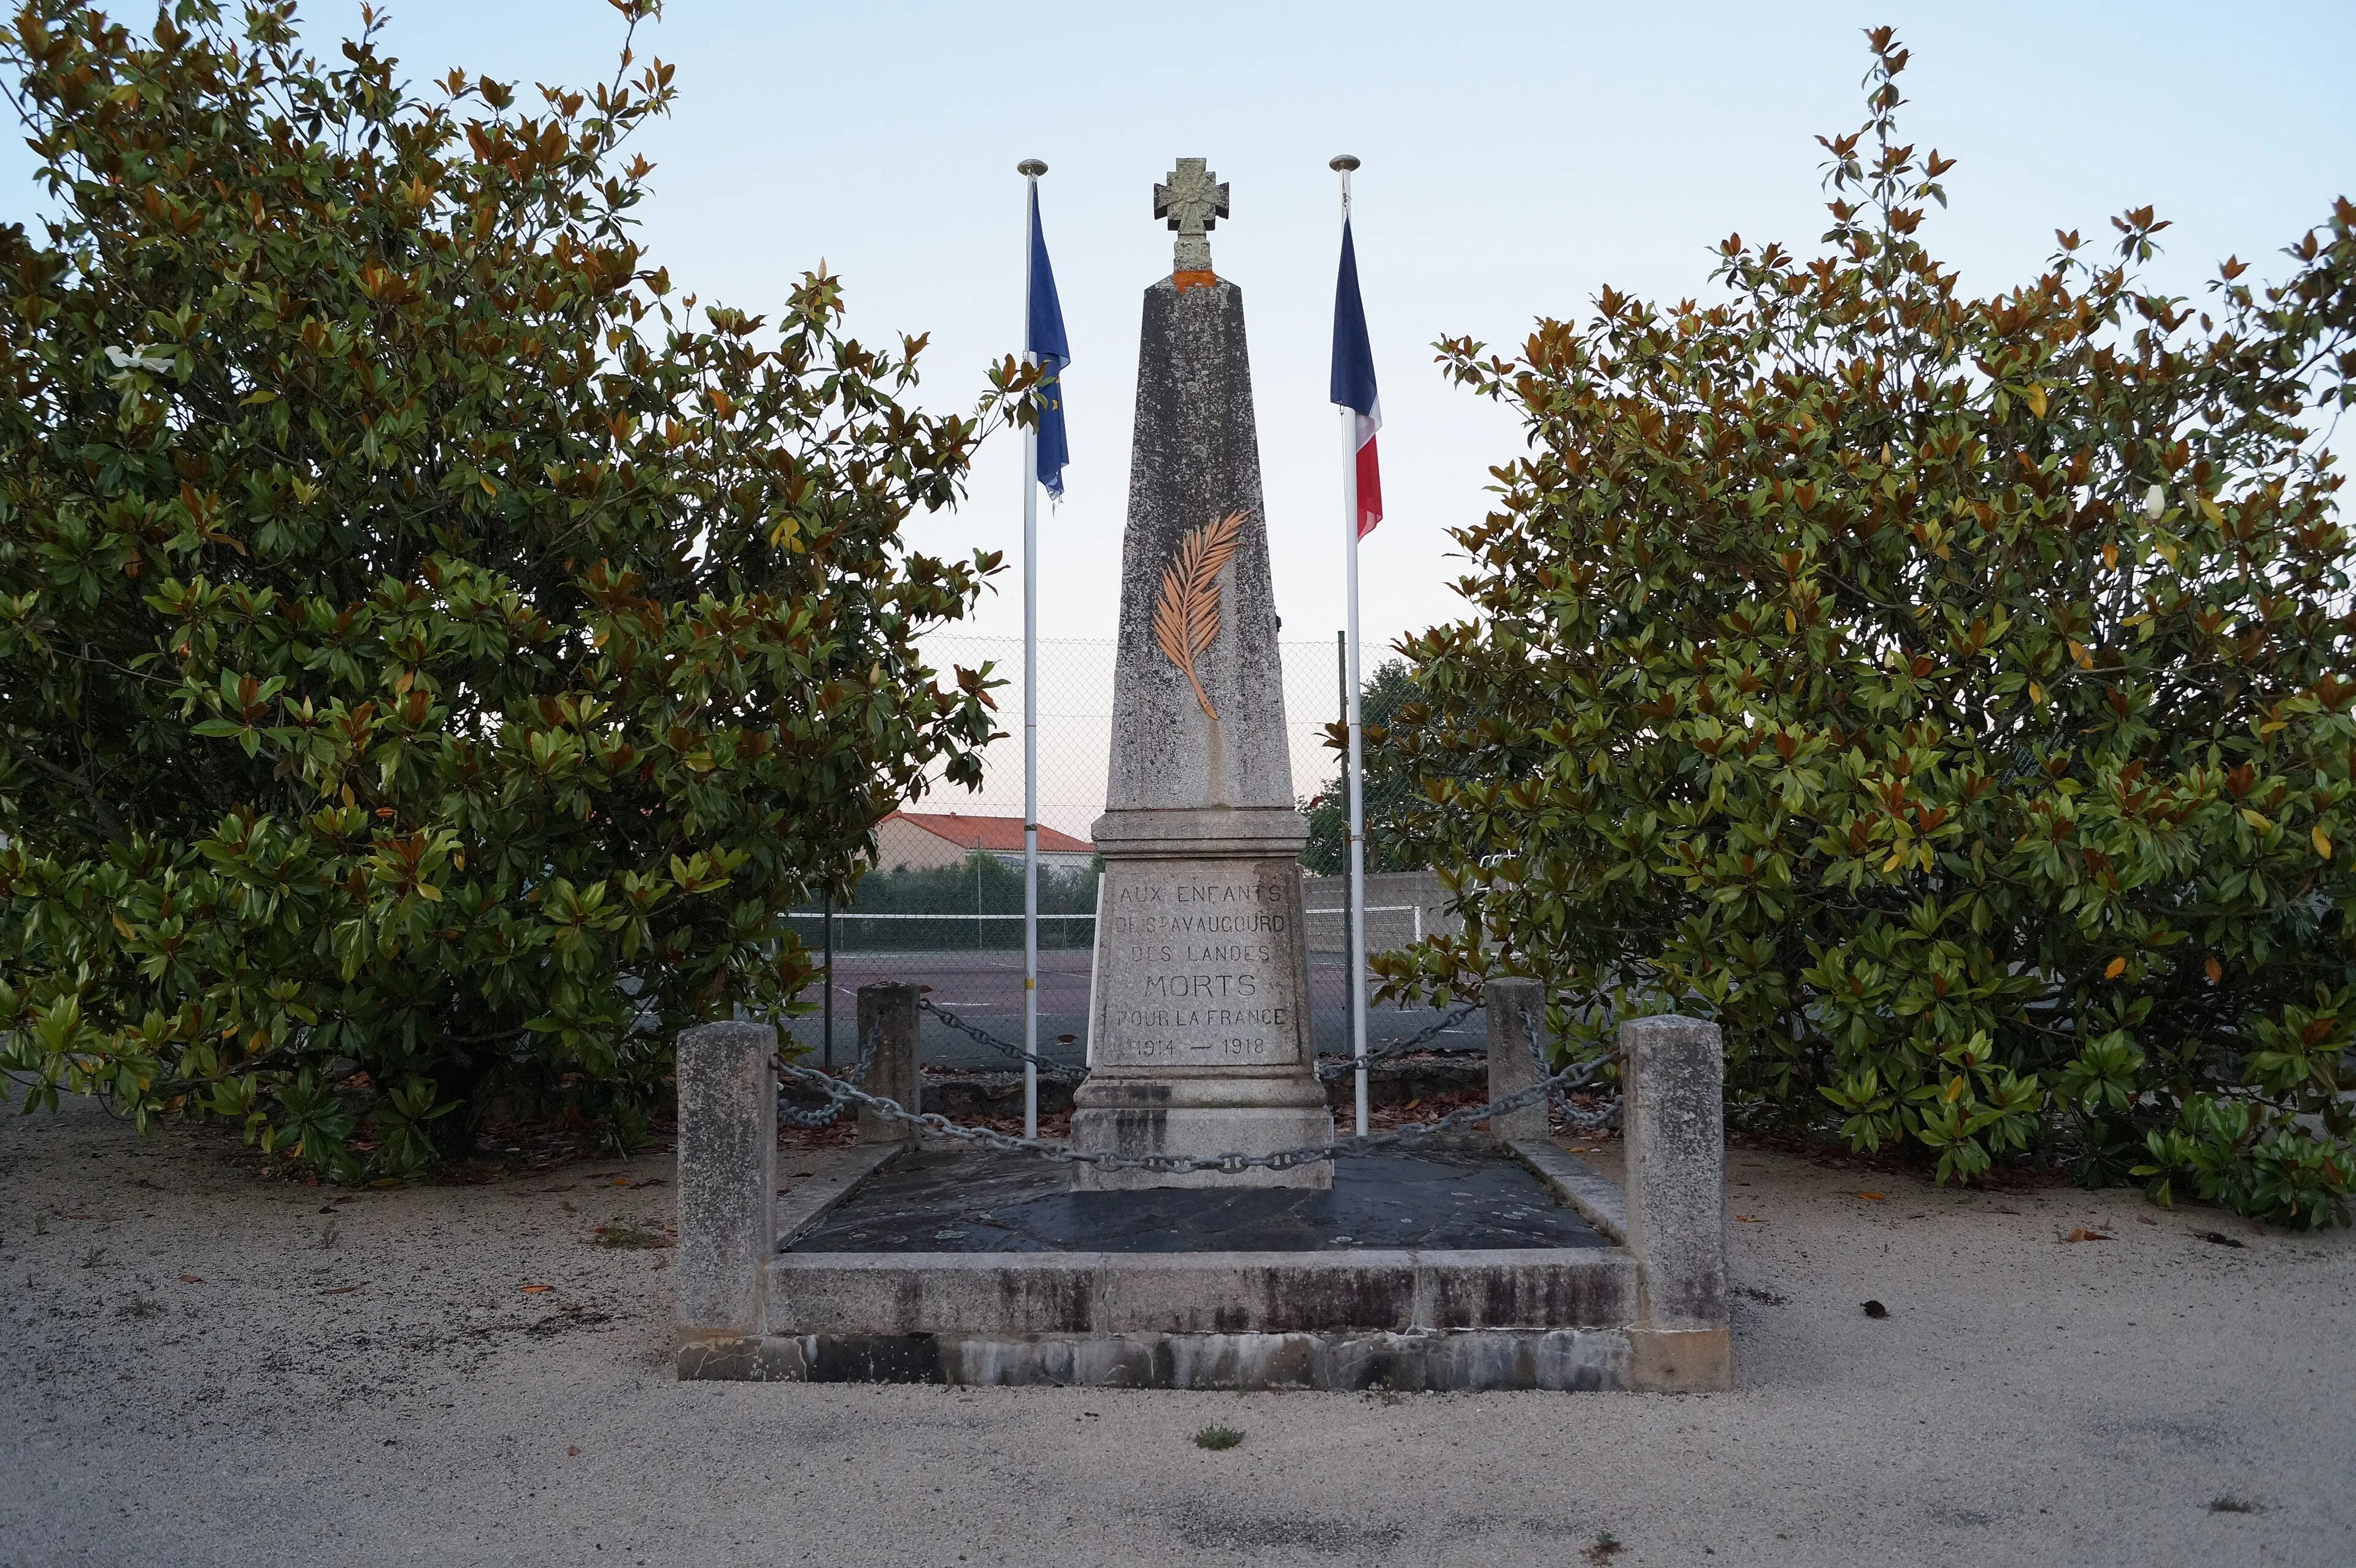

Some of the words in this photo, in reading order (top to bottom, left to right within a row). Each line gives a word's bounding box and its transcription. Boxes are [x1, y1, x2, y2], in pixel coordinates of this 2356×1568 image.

[1120, 886, 1163, 902] AUX
[1177, 886, 1281, 902] ENFANTS
[1116, 917, 1138, 932] DE
[1171, 915, 1284, 933] AVAUGOURD
[1132, 945, 1171, 962] DES
[1187, 945, 1269, 962] LANDES
[1144, 975, 1256, 998] MORTS
[1118, 1010, 1168, 1026] POUR
[1176, 1010, 1199, 1026] LA
[1207, 1009, 1285, 1026] FRANCE
[1137, 1040, 1174, 1056] 1914
[1222, 1039, 1264, 1056] 1918
